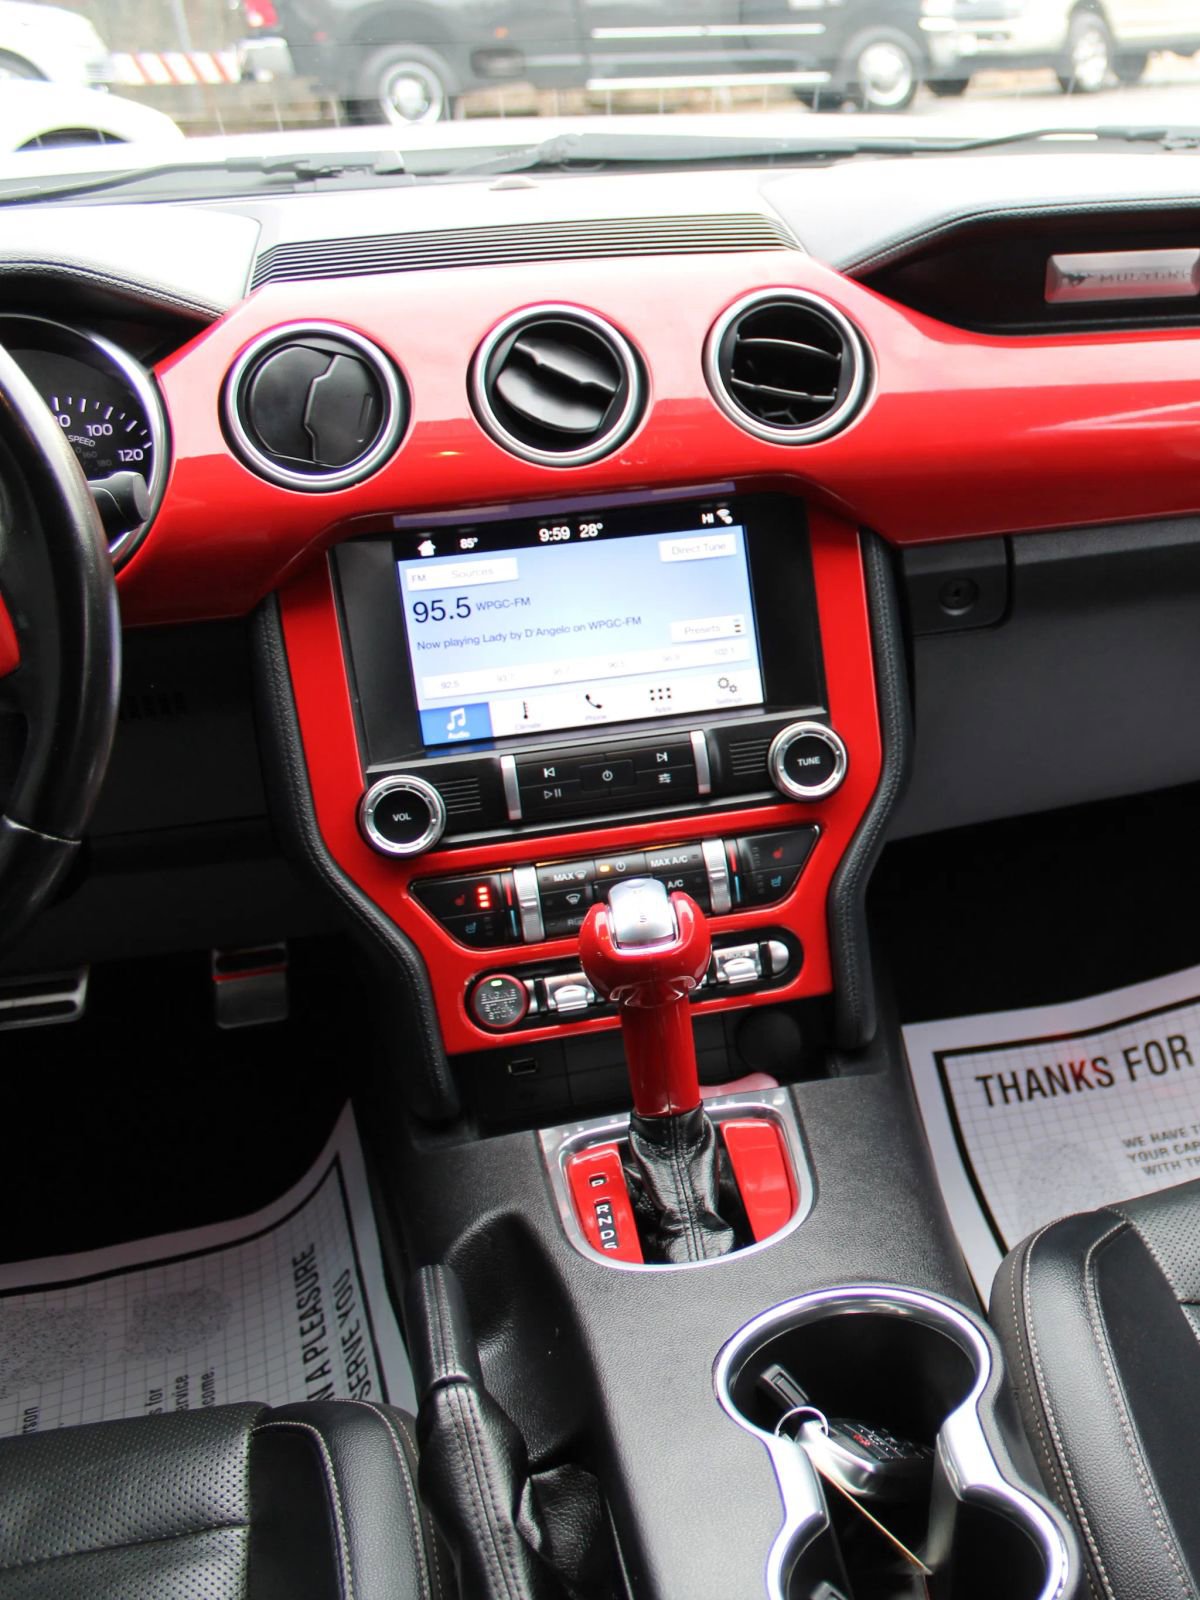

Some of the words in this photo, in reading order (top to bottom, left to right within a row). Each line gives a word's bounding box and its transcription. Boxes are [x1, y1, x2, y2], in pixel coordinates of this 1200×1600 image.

[54, 413, 71, 428] 0
[86, 424, 113, 437] 100
[67, 434, 96, 448] SPEED
[118, 448, 144, 462] 120
[539, 526, 571, 542] 9:59
[411, 574, 427, 583] FM
[412, 596, 471, 624] 95.5
[476, 596, 531, 612] WPGC-FM
[417, 639, 442, 651] Now
[443, 634, 480, 650] playing
[482, 630, 506, 644] Lady
[509, 629, 523, 642] by
[573, 623, 586, 633] on
[588, 616, 641, 632] WPGC-FM
[797, 756, 821, 766] TUNE
[392, 812, 412, 821] VOL
[650, 858, 671, 867] MAX
[672, 855, 688, 865] A/C
[553, 872, 574, 883] MAX
[667, 879, 684, 888] A/C
[976, 1056, 1115, 1107] THANKS
[1123, 1034, 1195, 1082] FOR
[1122, 1136, 1145, 1149] WE
[1149, 1127, 1186, 1143] HAVE
[1127, 1147, 1169, 1163] YOUR
[1142, 1159, 1182, 1176] WITH
[596, 1204, 609, 1214] R
[598, 1215, 612, 1226] N
[601, 1230, 615, 1240] D
[292, 1243, 329, 1366] PLEASURE
[333, 1268, 356, 1329] YOU
[341, 1318, 371, 1400] SERVE
[175, 1373, 190, 1411] ervice
